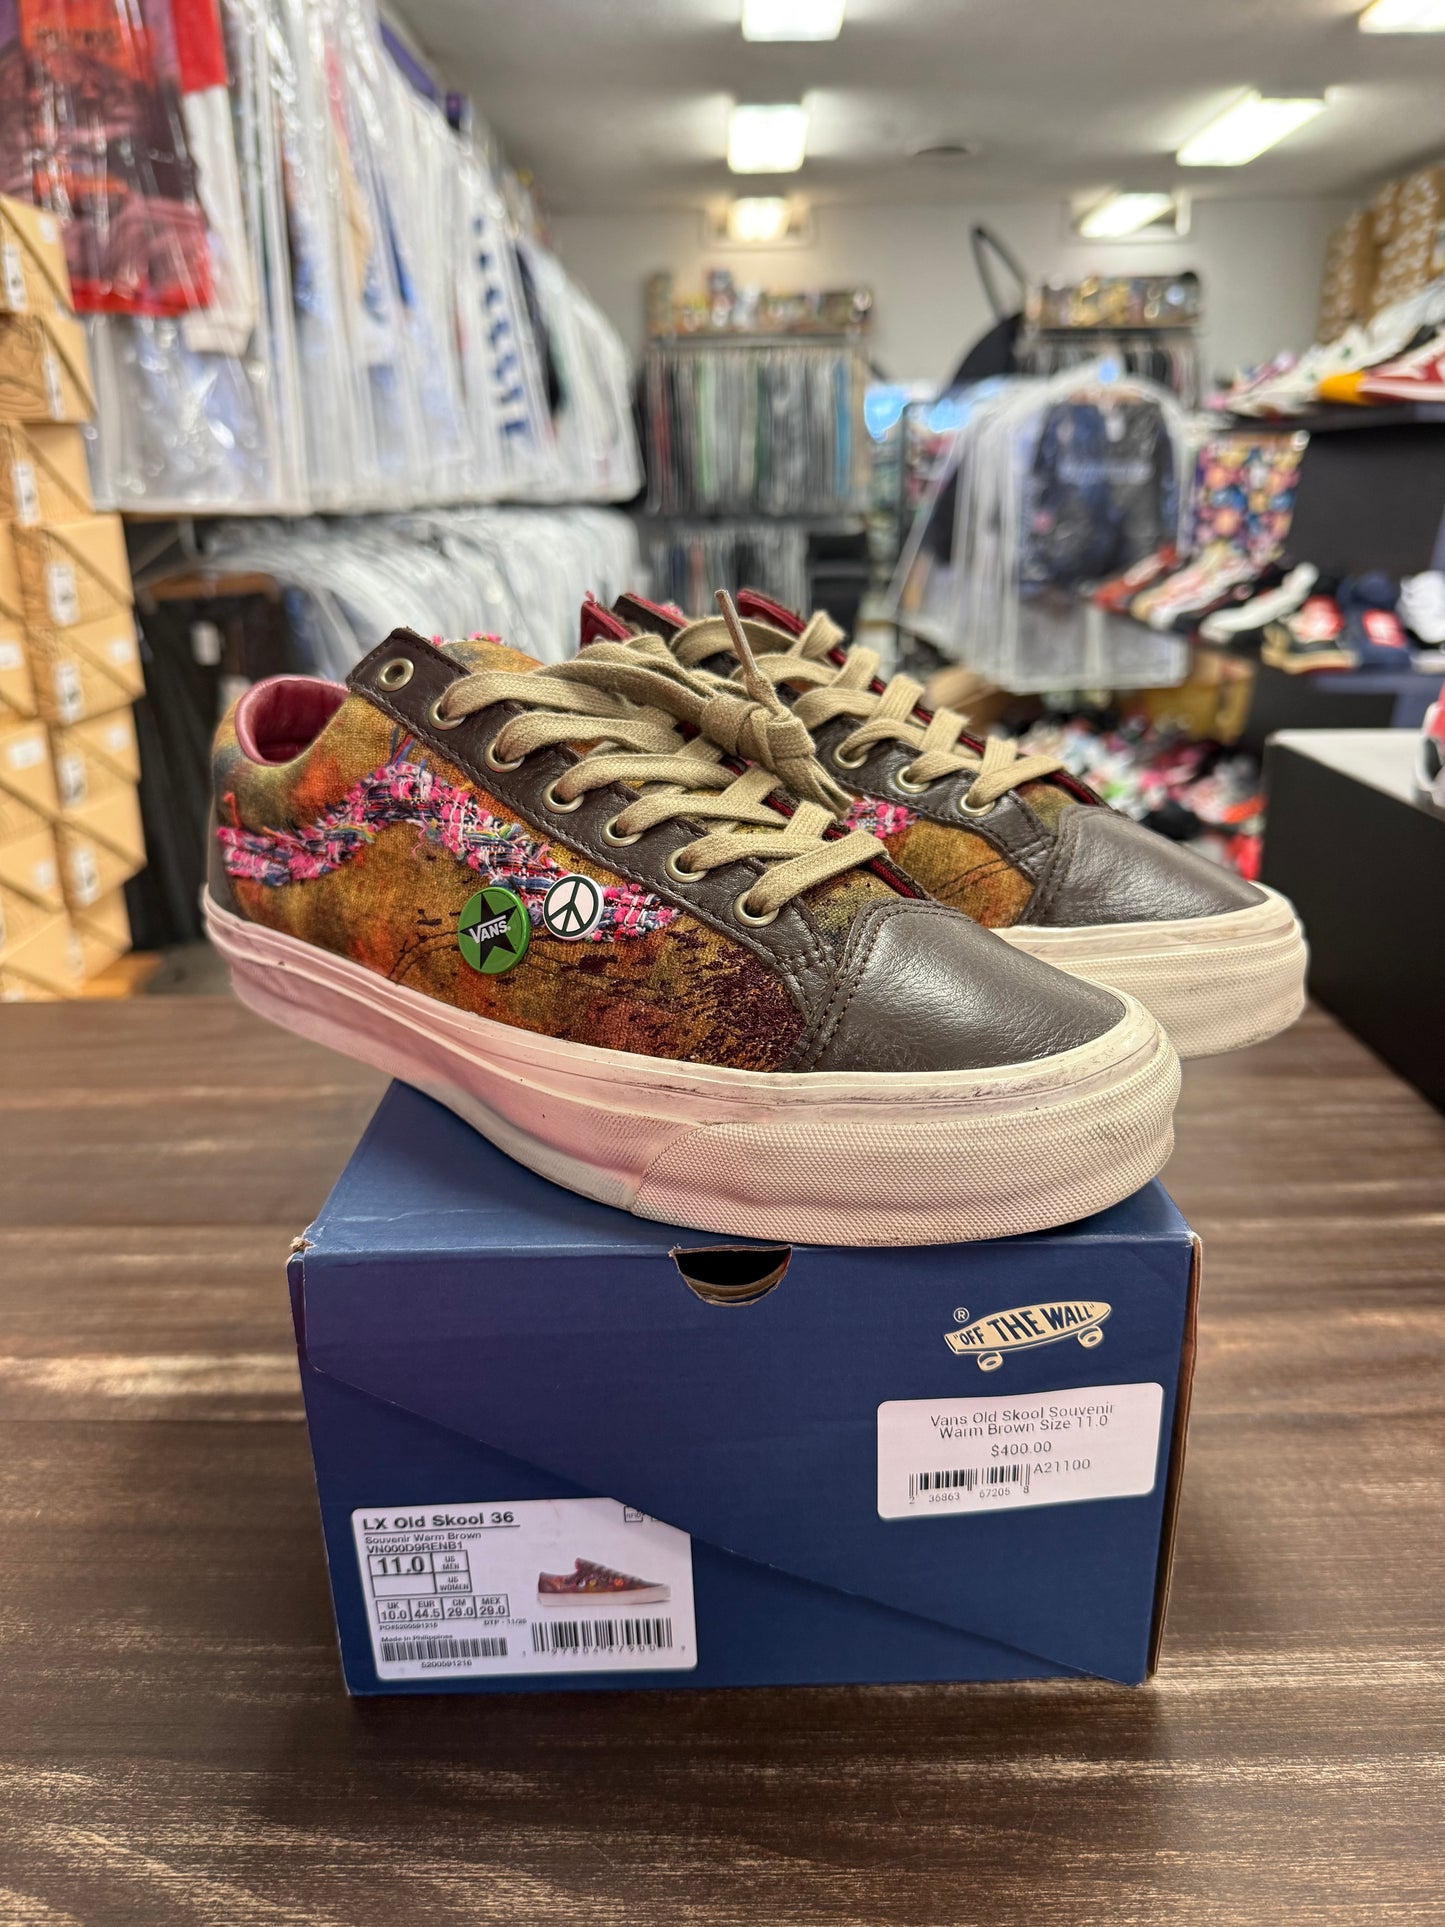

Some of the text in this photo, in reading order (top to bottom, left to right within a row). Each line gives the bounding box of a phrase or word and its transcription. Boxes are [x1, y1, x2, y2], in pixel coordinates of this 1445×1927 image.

[469, 915, 508, 944] VANS
[986, 1310, 1045, 1342] THE
[930, 1402, 1115, 1427] Vans Old Skool Souvenir
[939, 1415, 1108, 1439] Warm Brown Size 11.0
[991, 1441, 1052, 1458] $400.00
[1033, 1458, 1091, 1474] A21100
[928, 1492, 960, 1503] 36863
[979, 1487, 1011, 1499] 67205
[1023, 1485, 1029, 1494] 8
[363, 1511, 515, 1530] LX Old Skool 36
[365, 1532, 481, 1544] Souvenir Warm Brown
[378, 1555, 425, 1574] 11.0
[418, 1600, 435, 1608] EUR
[482, 1597, 501, 1605] MEX
[381, 1605, 505, 1620] 10.0 44.5 29.0 29.0
